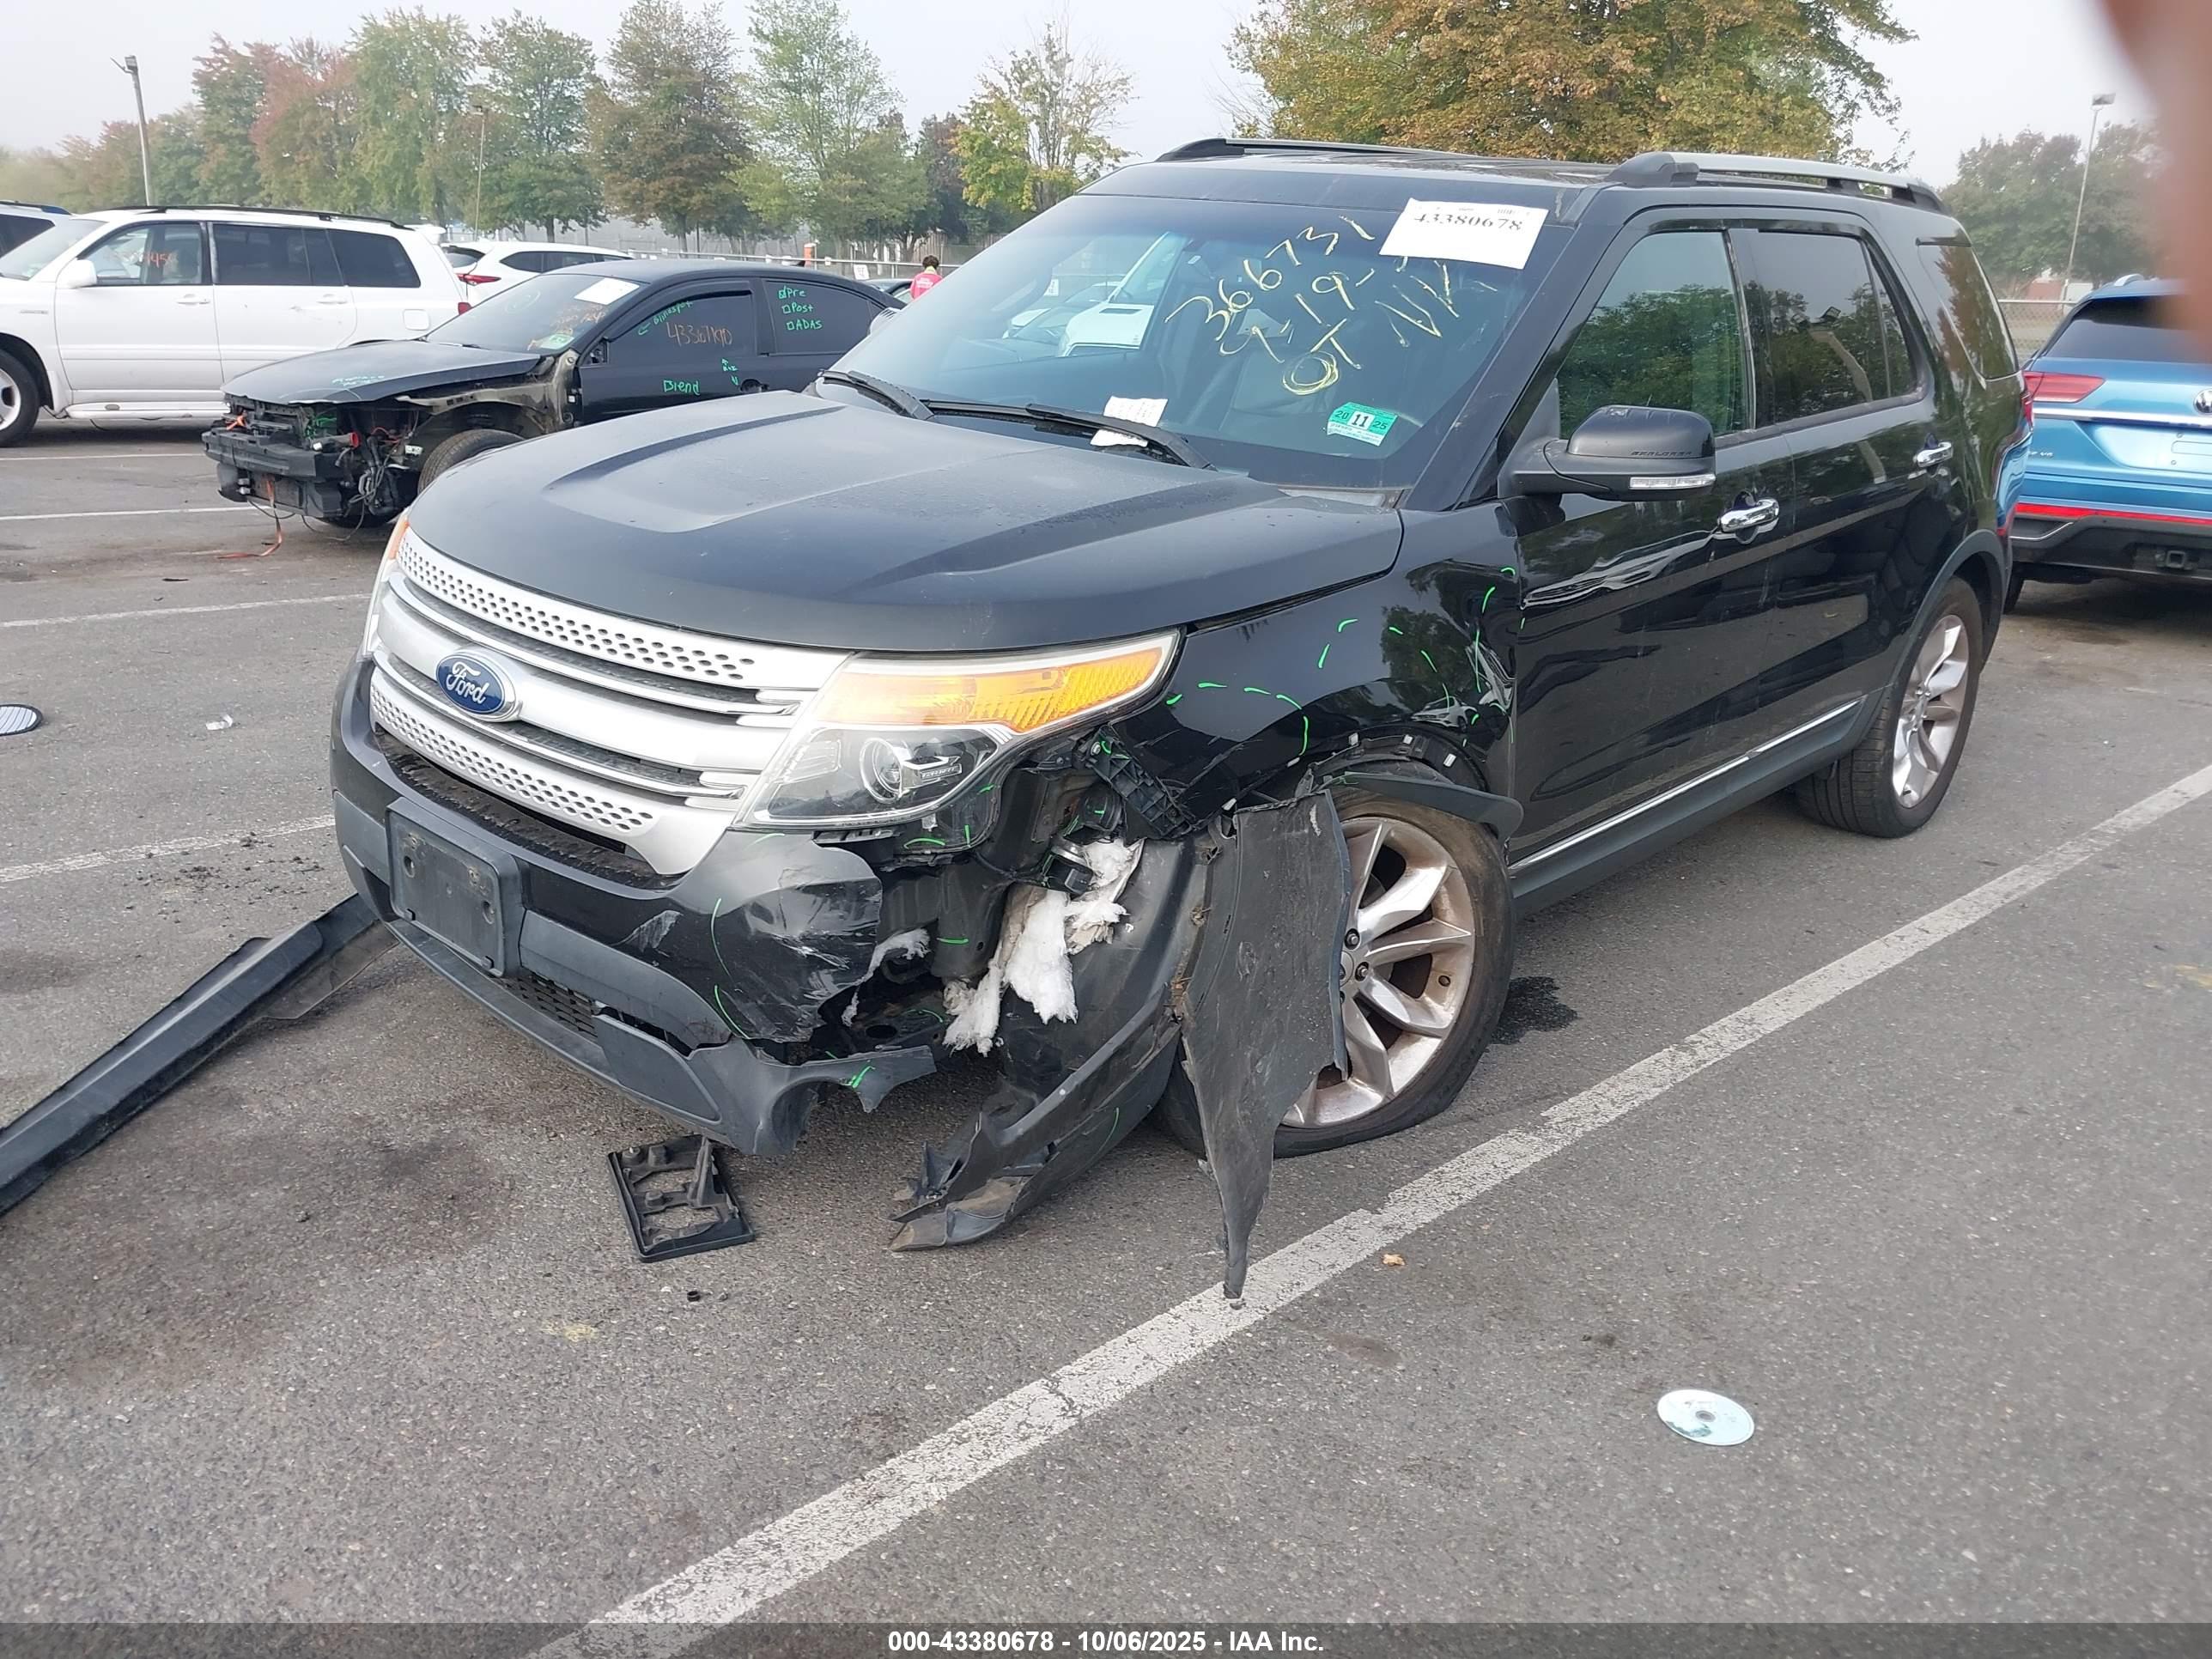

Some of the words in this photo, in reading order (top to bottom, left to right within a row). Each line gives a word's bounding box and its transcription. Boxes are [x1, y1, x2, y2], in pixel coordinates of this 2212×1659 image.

[1414, 213, 1523, 231] 43380678
[1164, 215, 1376, 341] 366731
[792, 302, 813, 313] Post
[796, 319, 823, 331] ADAS
[1352, 414, 1369, 428] 11
[1373, 421, 1388, 429] 25
[446, 661, 490, 704] Ford
